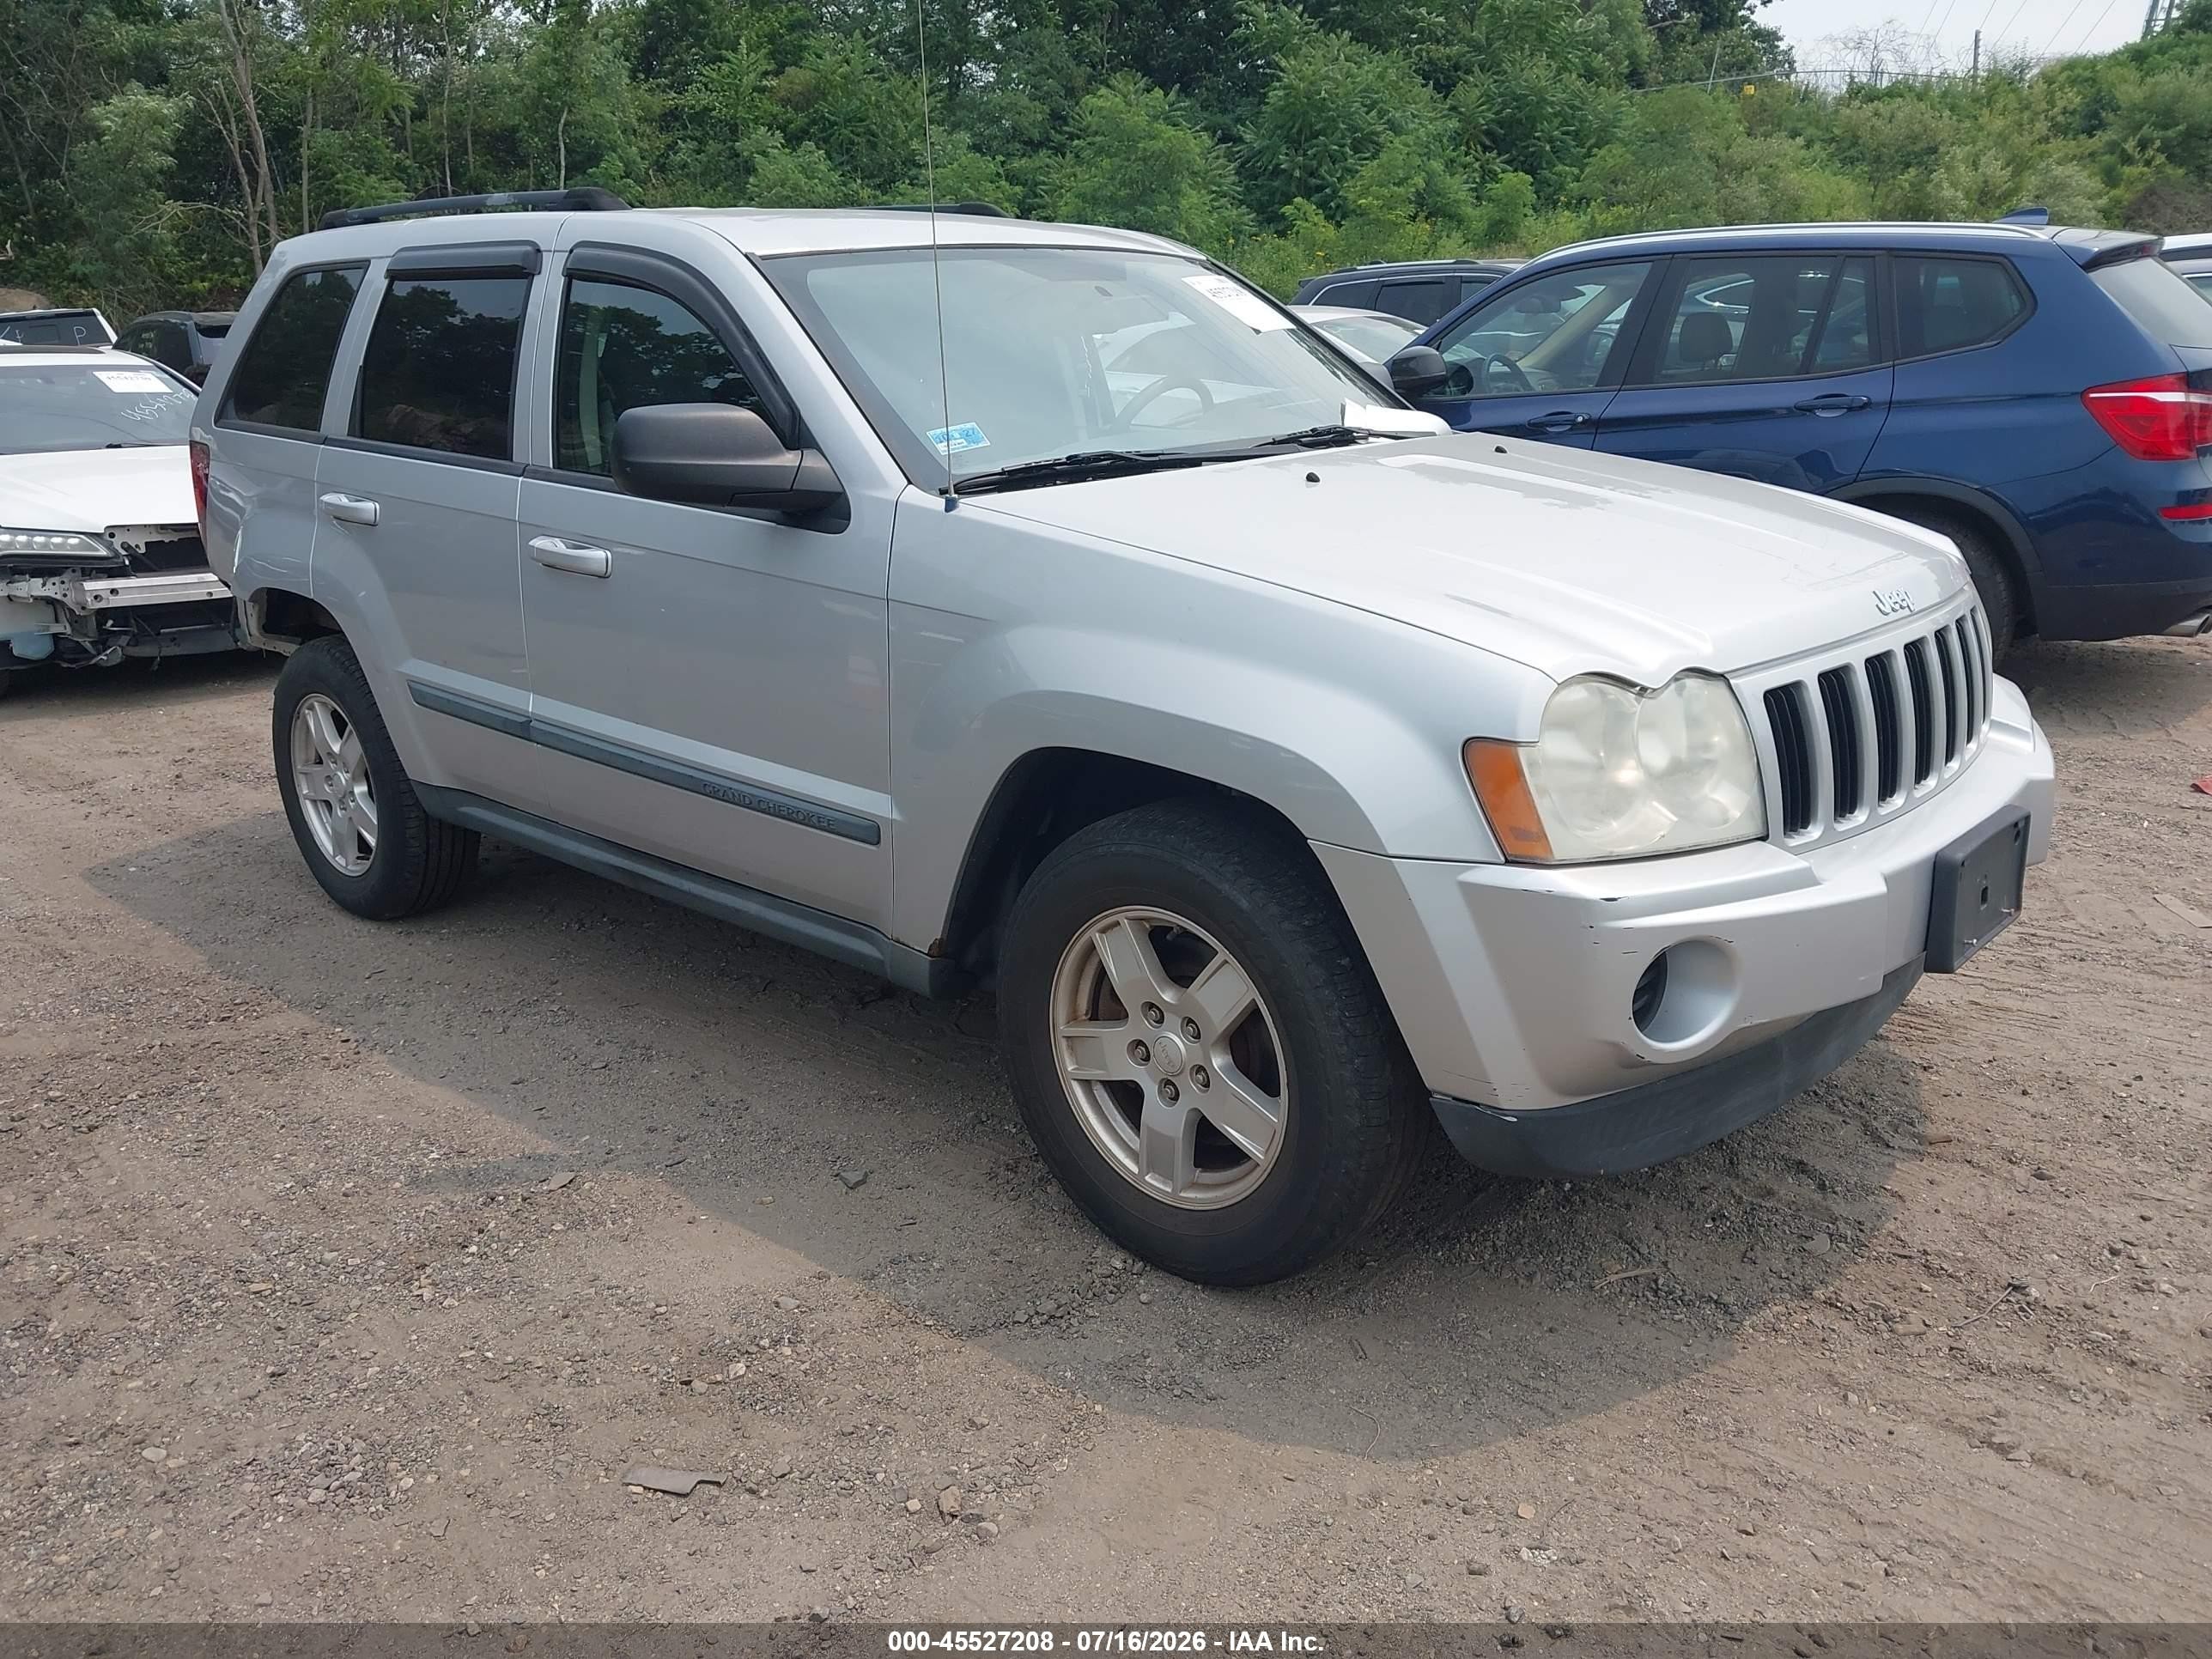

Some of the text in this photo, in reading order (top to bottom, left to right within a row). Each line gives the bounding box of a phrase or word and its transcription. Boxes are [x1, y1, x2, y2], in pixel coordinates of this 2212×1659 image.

[73, 325, 88, 346] P
[1872, 587, 1916, 617] Jeep
[702, 782, 837, 829] GRAND CHEROKEE
